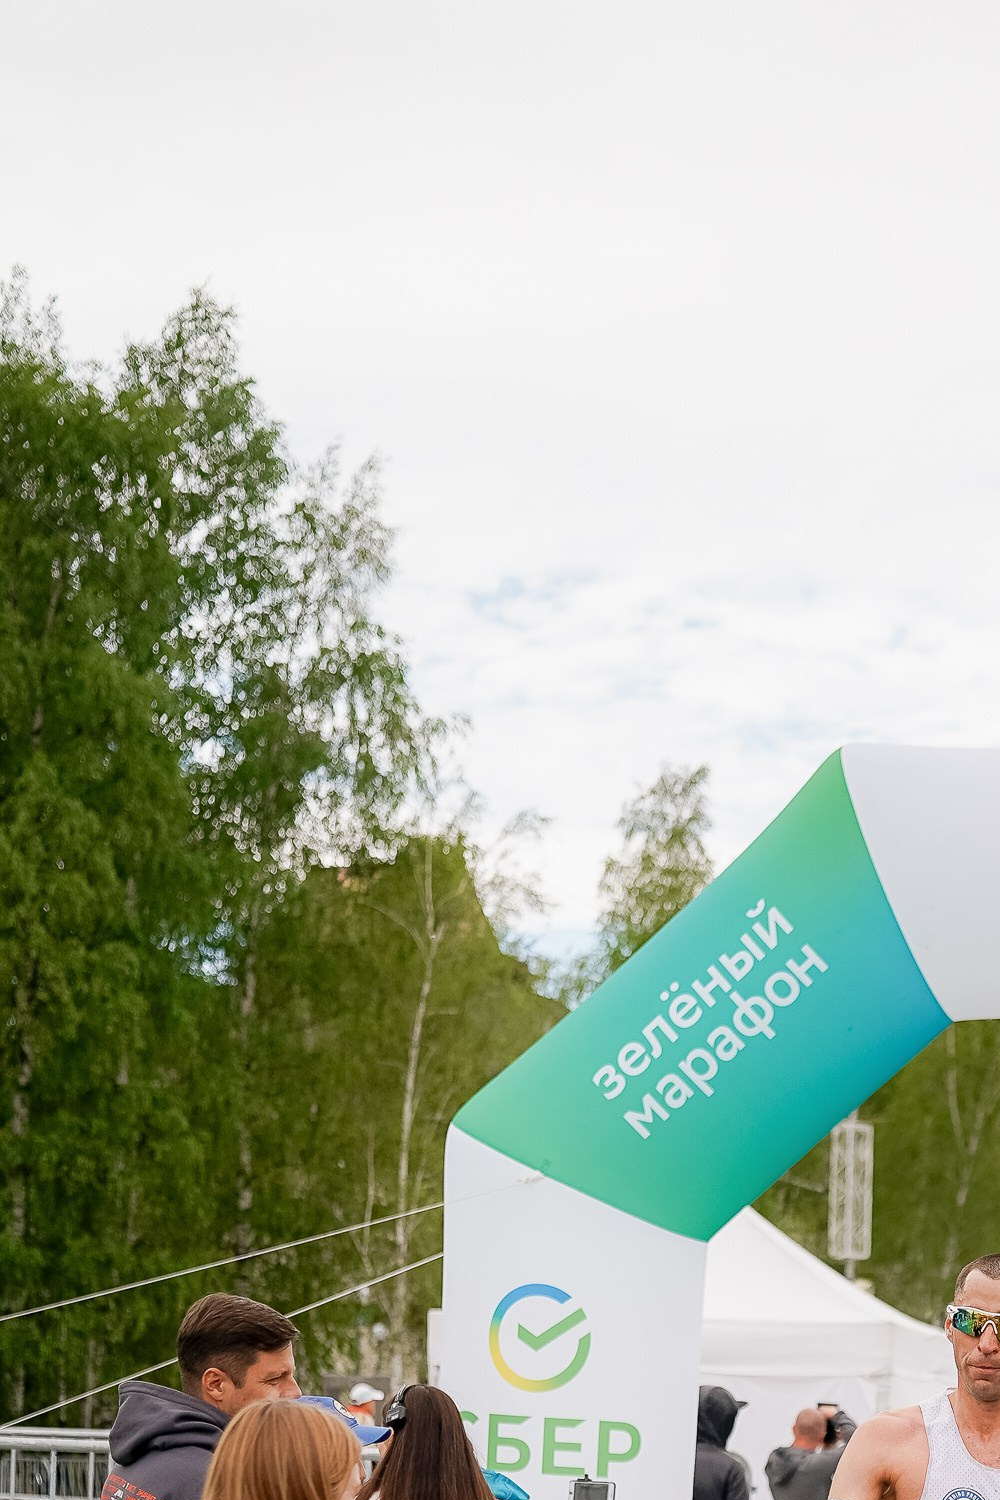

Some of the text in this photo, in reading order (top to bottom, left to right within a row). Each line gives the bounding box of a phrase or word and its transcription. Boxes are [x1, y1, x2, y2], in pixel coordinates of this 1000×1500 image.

[592, 898, 794, 1100] зелёный
[623, 943, 829, 1140] марафон
[459, 1410, 642, 1478] БЕР
